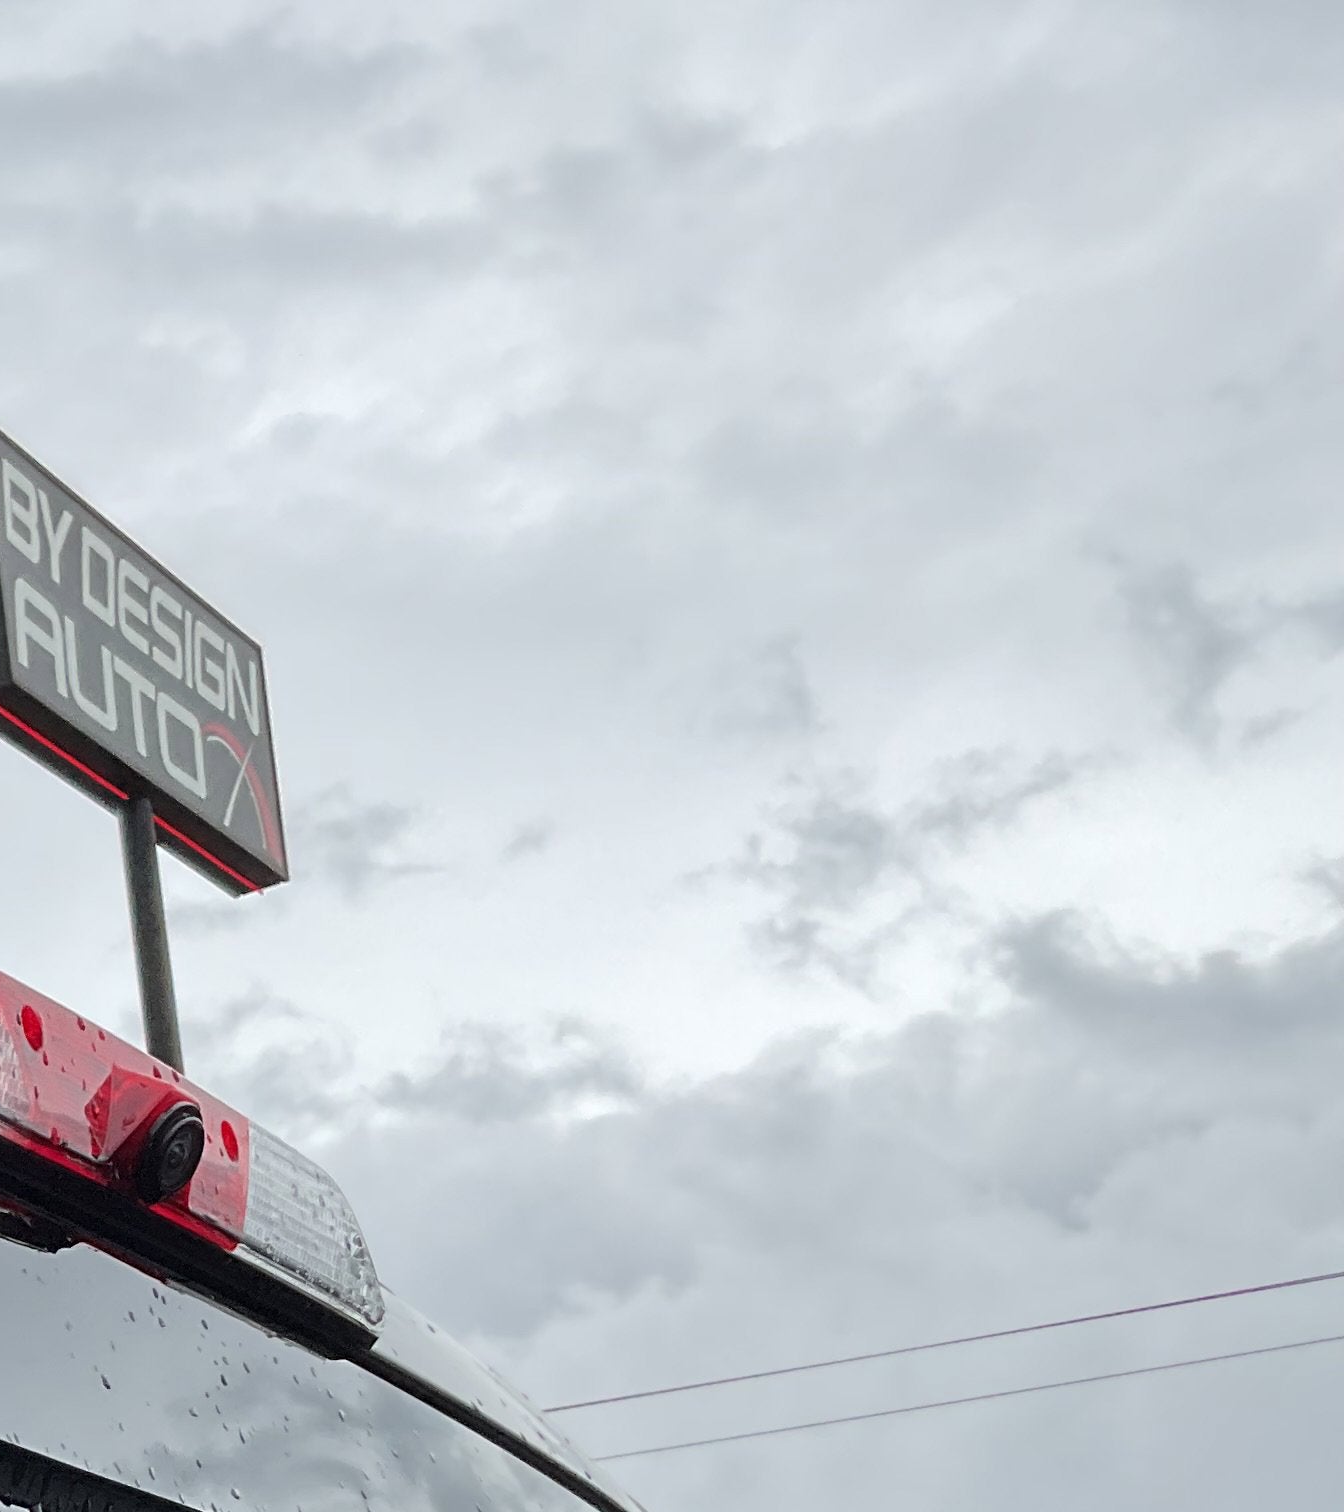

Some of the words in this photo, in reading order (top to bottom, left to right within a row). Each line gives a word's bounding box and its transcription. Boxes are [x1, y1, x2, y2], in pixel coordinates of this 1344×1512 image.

[2, 459, 73, 584] BY
[81, 526, 260, 736] DESIGN
[14, 577, 207, 799] AUTO
